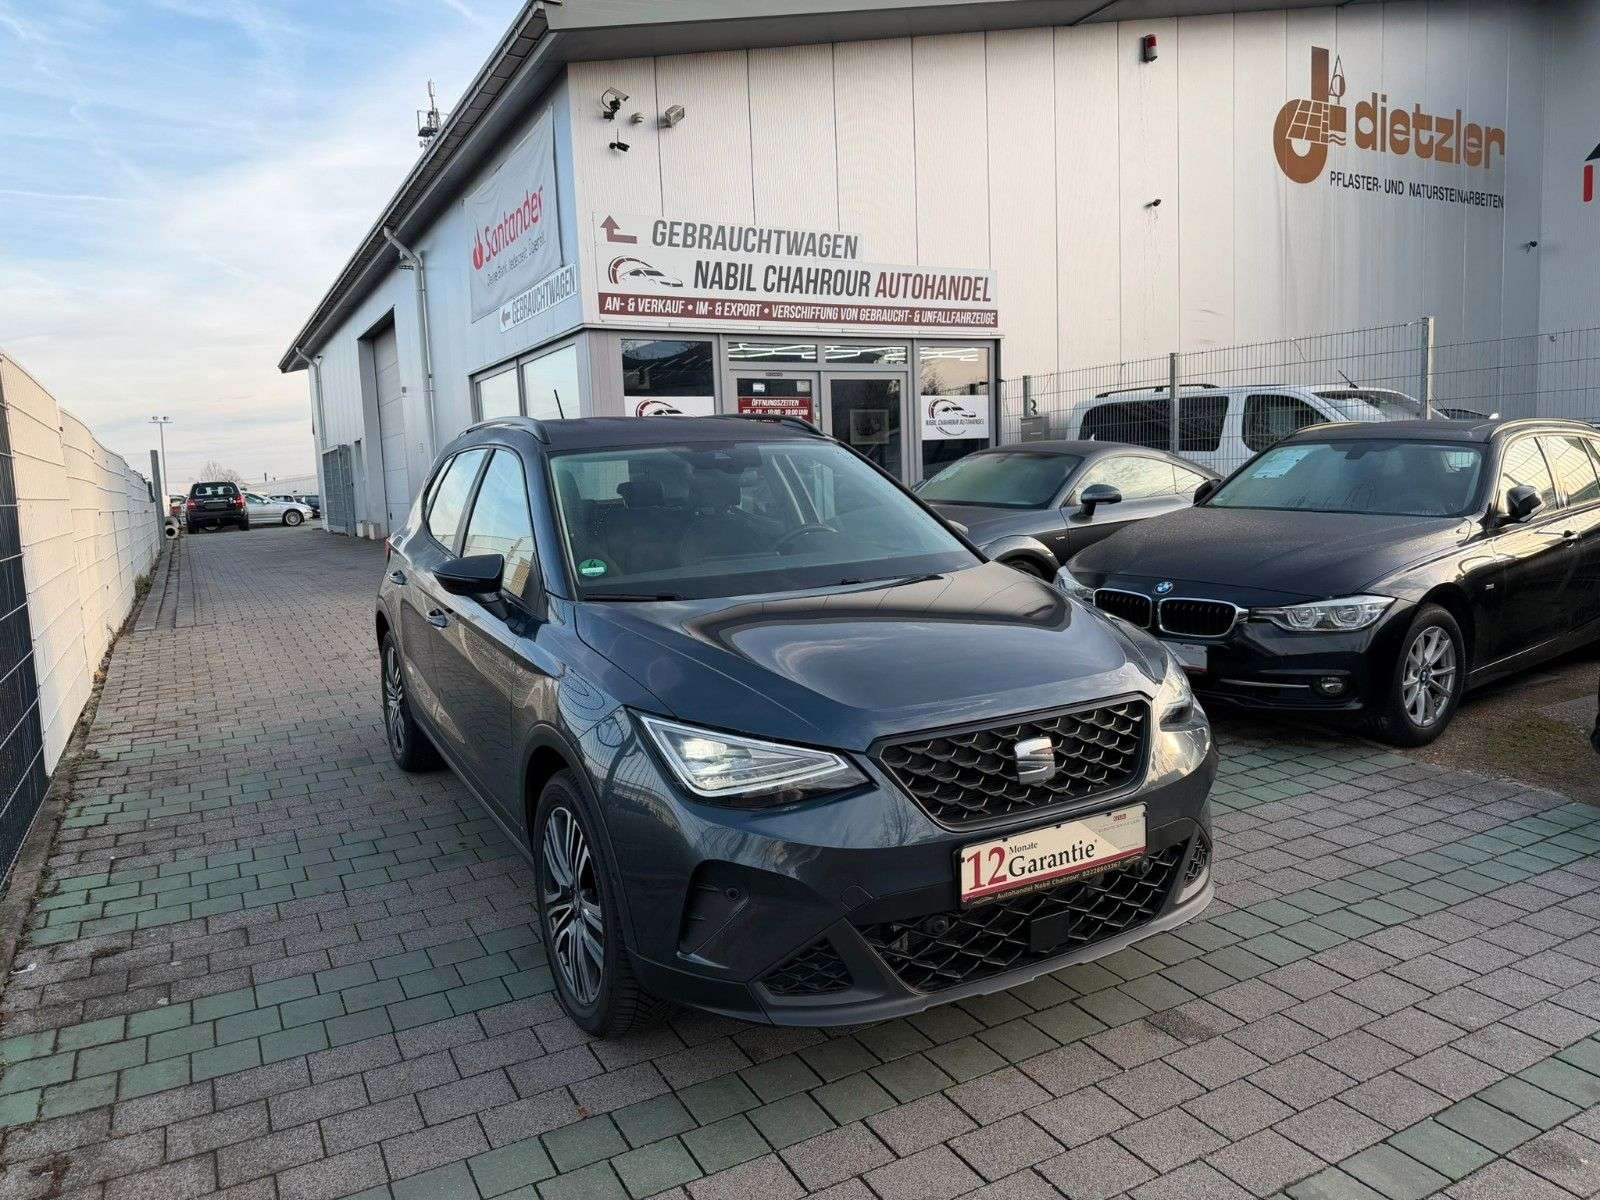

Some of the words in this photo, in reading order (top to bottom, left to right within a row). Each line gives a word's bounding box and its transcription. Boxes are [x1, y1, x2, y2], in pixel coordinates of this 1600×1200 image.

[1355, 92, 1505, 169] dietzler
[1330, 171, 1382, 192] PFLASTER-
[1384, 180, 1404, 195] UND
[1409, 183, 1504, 208] NATURSTEINARBEITEN
[484, 184, 544, 262] Santander
[652, 219, 859, 260] GEBRAUCHTWAGEN
[511, 270, 577, 325] GEBRAUCHTWAGEN
[694, 260, 757, 292] NABIL
[763, 265, 872, 298] CHAHROUR
[875, 271, 992, 302] AUTOHANDEL
[604, 296, 625, 311] AN-
[627, 297, 635, 312] &
[638, 298, 685, 315] VERKAUF
[696, 301, 713, 315] IM-
[715, 302, 723, 316] &
[724, 302, 762, 318] EXPORT
[771, 305, 838, 321] VERSCHIFFUNG
[840, 309, 859, 321] VON
[859, 309, 912, 324] GEBRAUCHT-
[913, 311, 920, 323] &
[921, 310, 996, 325] UNFALLFAHRZEUGE
[967, 847, 1008, 891] 12
[1008, 842, 1039, 855] Monate
